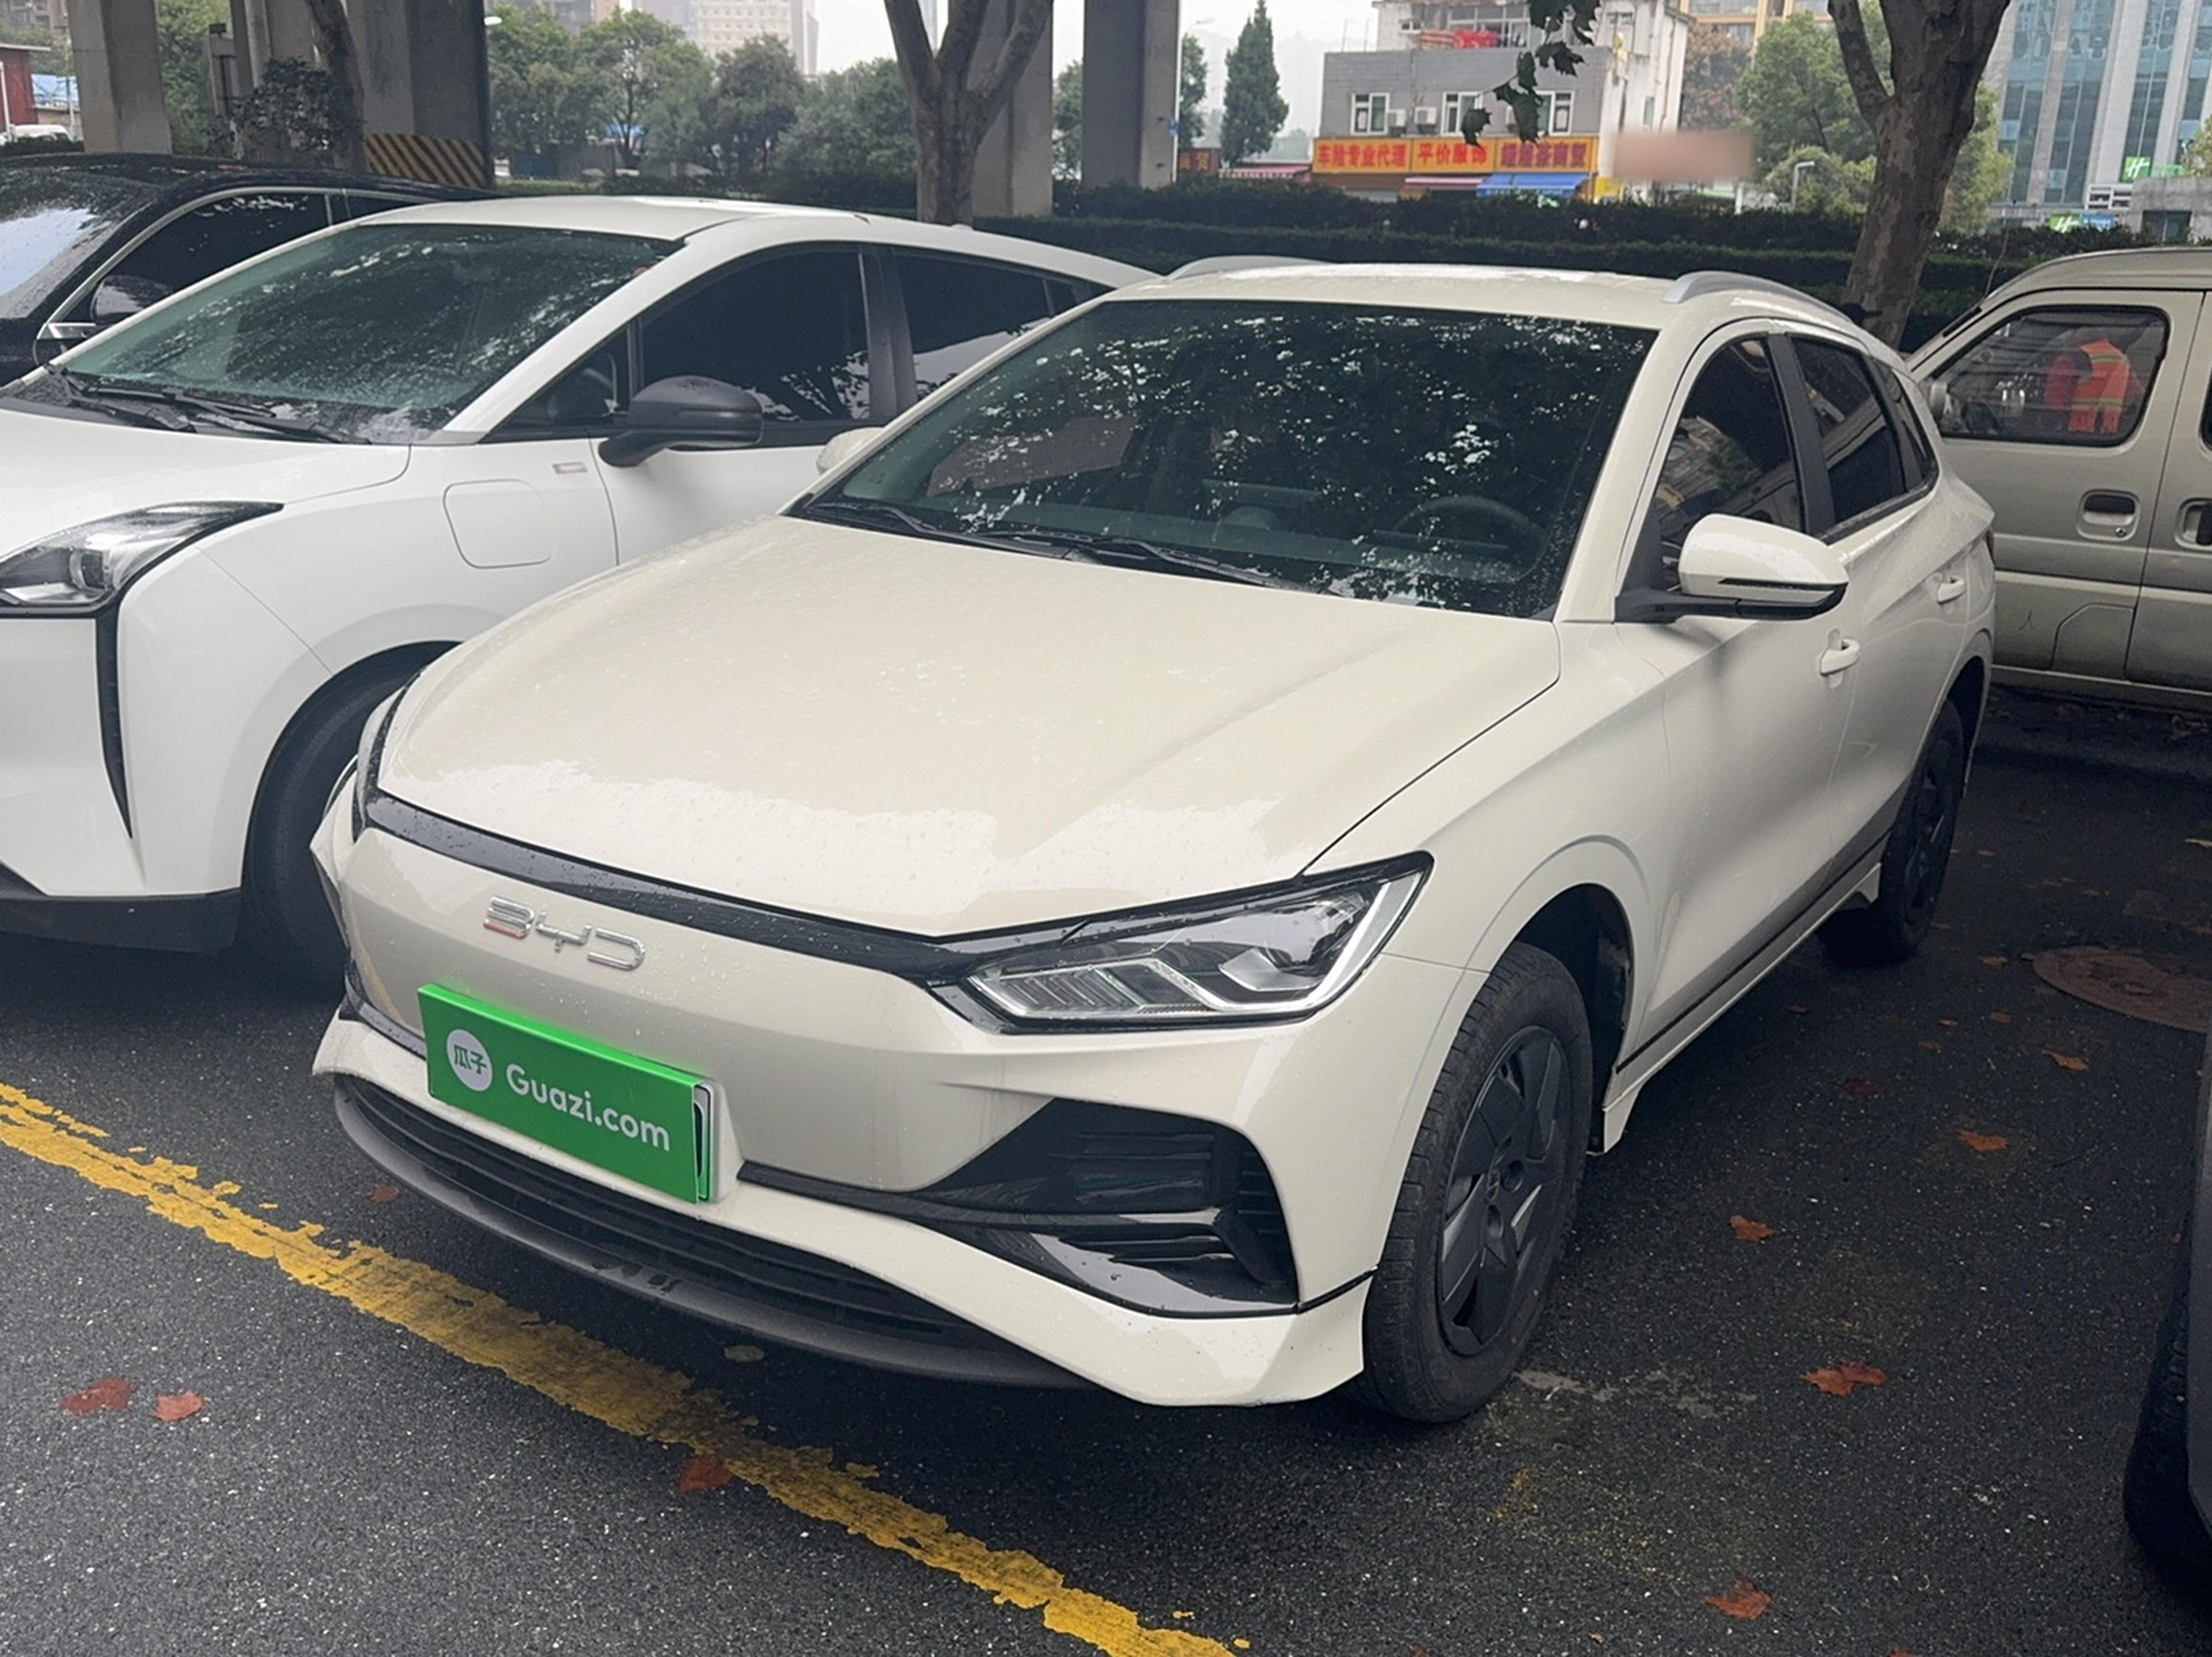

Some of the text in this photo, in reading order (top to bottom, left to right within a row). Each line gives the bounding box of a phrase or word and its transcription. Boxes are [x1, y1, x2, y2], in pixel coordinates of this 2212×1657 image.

[1318, 143, 1406, 168] 车险专业代理
[1417, 142, 1488, 165] 平价服饰
[483, 895, 646, 971] BYD
